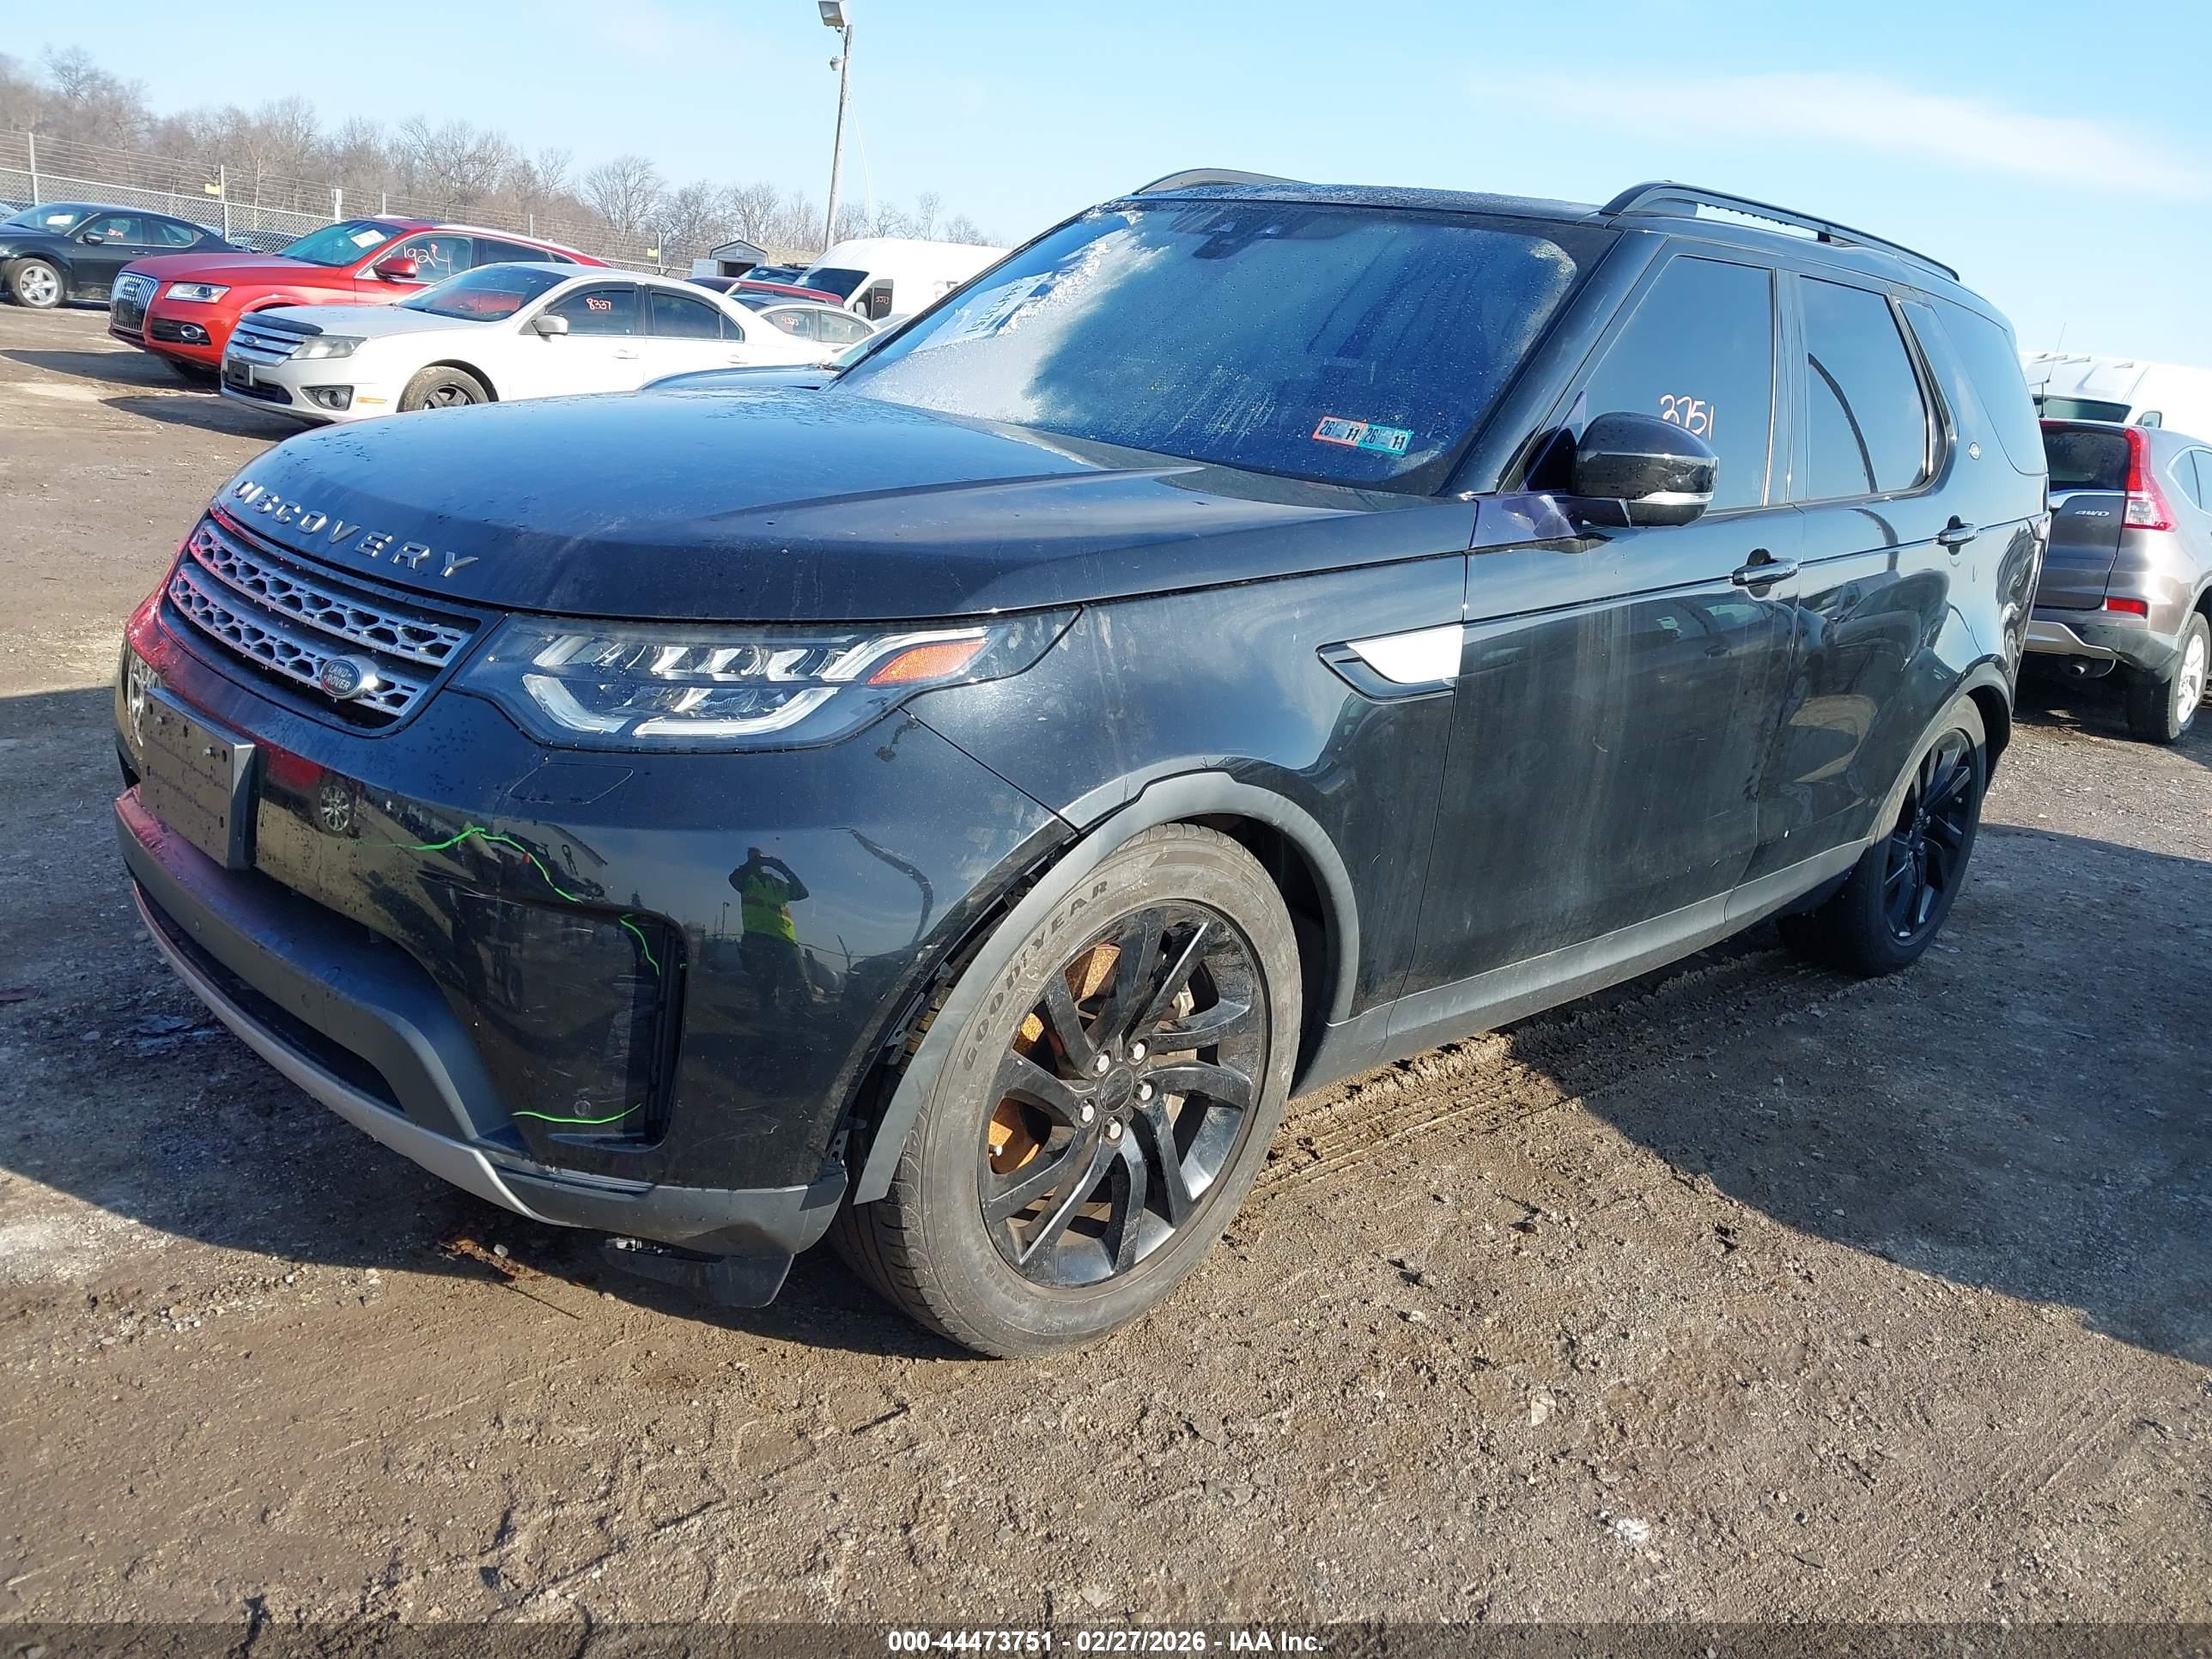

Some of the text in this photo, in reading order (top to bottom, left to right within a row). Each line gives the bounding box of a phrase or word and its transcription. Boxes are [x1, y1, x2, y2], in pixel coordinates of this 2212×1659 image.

[586, 297, 611, 310] 8337
[1319, 420, 1336, 436] 26
[1364, 428, 1379, 444] 26
[232, 480, 479, 578] DISCOVERY
[328, 664, 349, 678] LAND
[327, 674, 351, 691] ROVER
[963, 880, 1108, 1072] GOODYEAR
